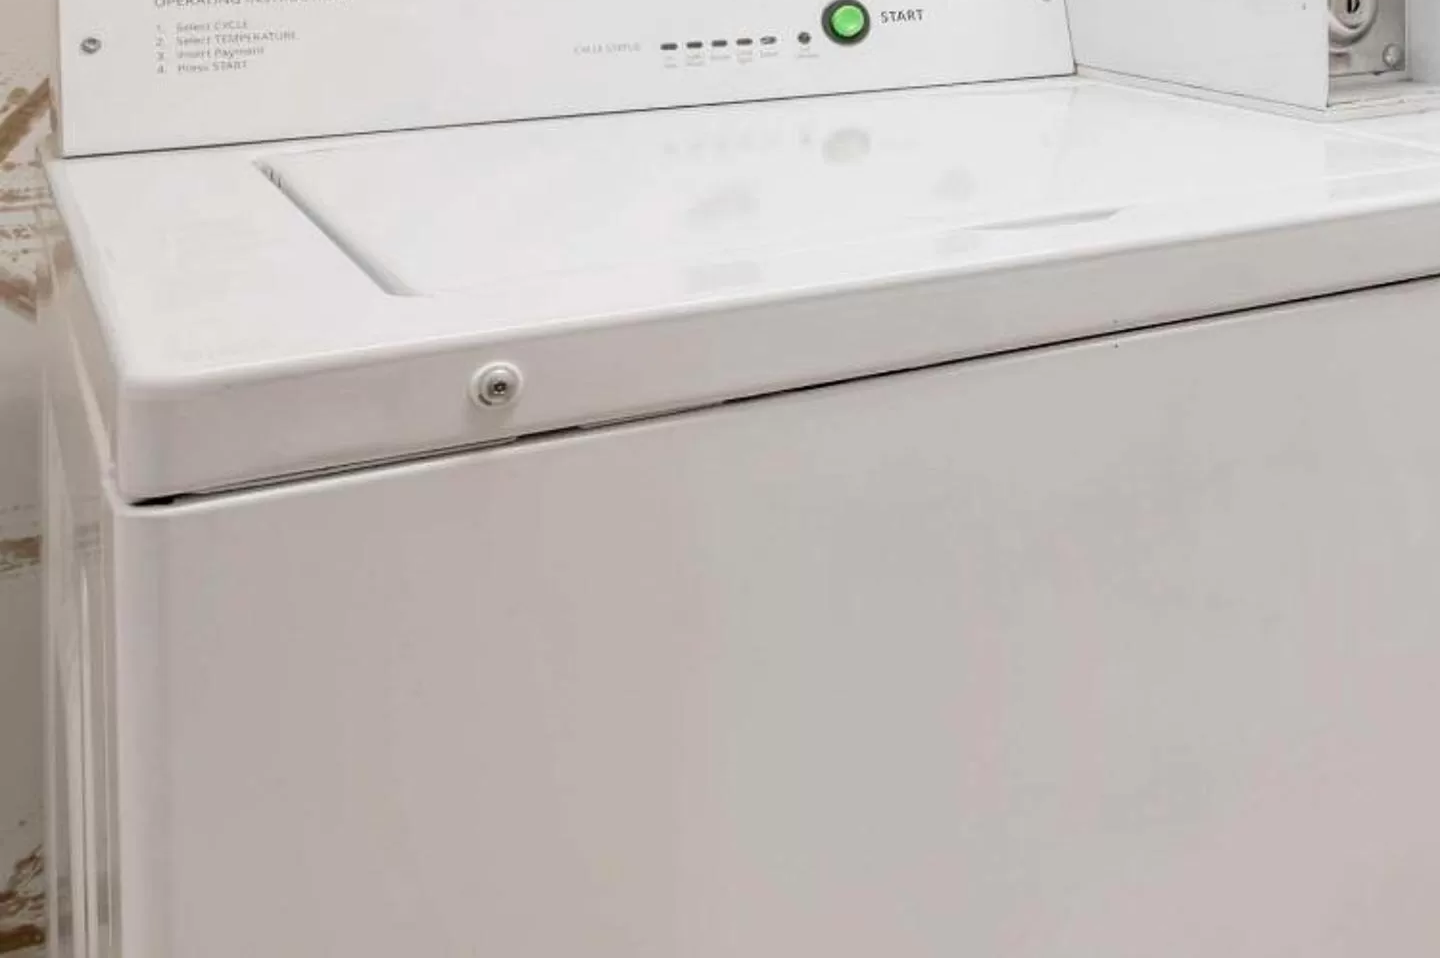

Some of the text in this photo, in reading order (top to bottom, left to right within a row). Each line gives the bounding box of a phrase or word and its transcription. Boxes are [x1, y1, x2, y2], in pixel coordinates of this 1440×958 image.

[880, 8, 925, 24] START
[176, 22, 210, 32] Select
[214, 20, 249, 31] CYCLE
[176, 35, 211, 46] Select
[214, 30, 297, 44] TEMPERATURE
[214, 46, 265, 60] Payment
[212, 60, 248, 72] START
